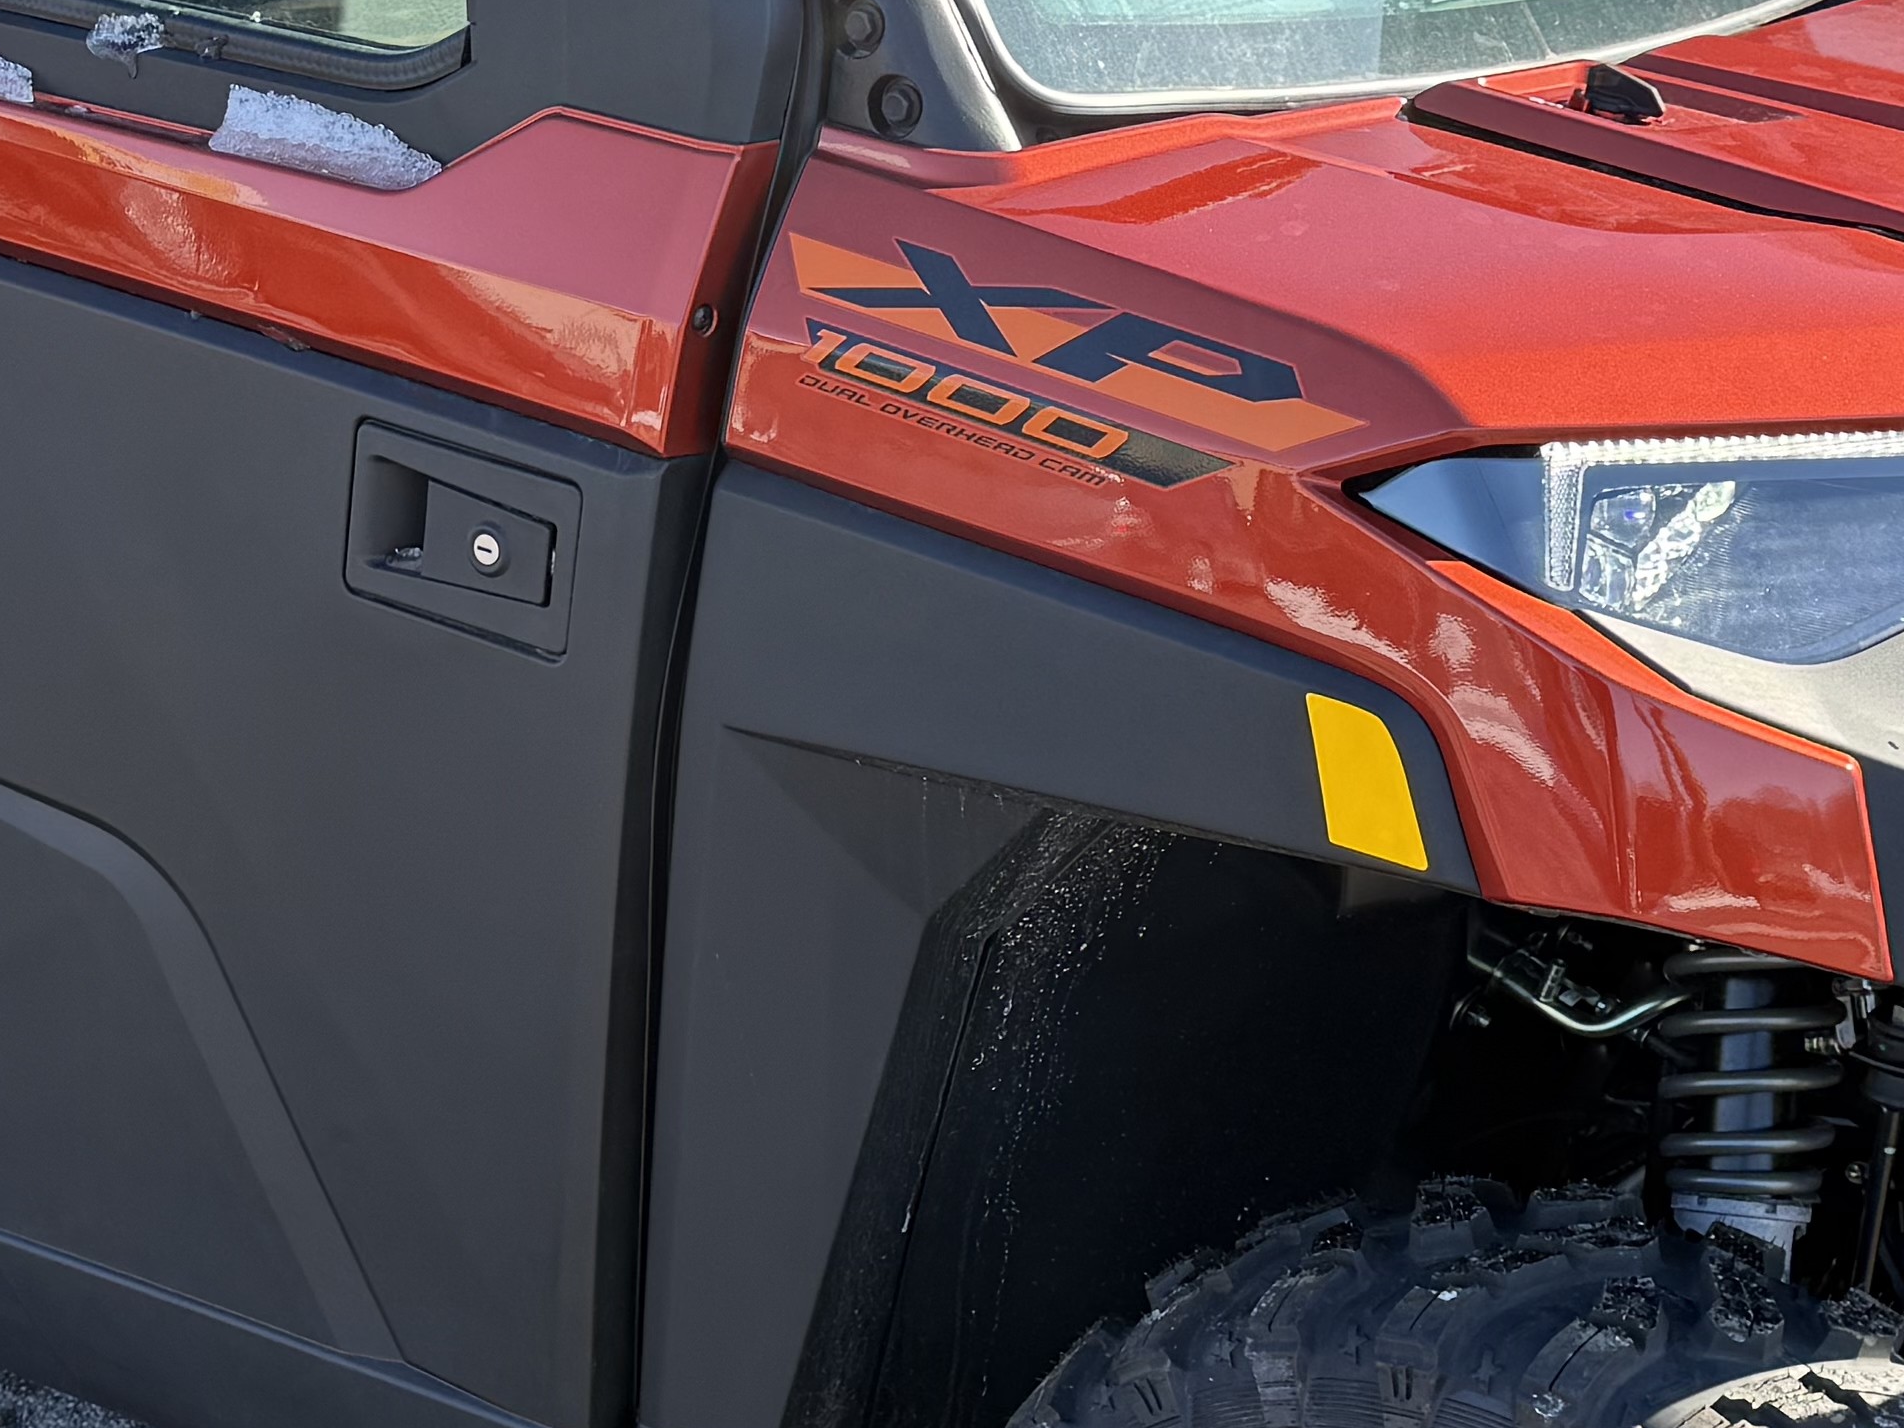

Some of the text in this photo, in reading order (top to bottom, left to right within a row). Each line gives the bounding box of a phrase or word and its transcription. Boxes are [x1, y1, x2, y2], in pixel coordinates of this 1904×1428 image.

[805, 238, 1304, 401] XP
[798, 374, 1108, 487] DUAL OVERHEAD CAM
[800, 329, 1129, 460] 1000
